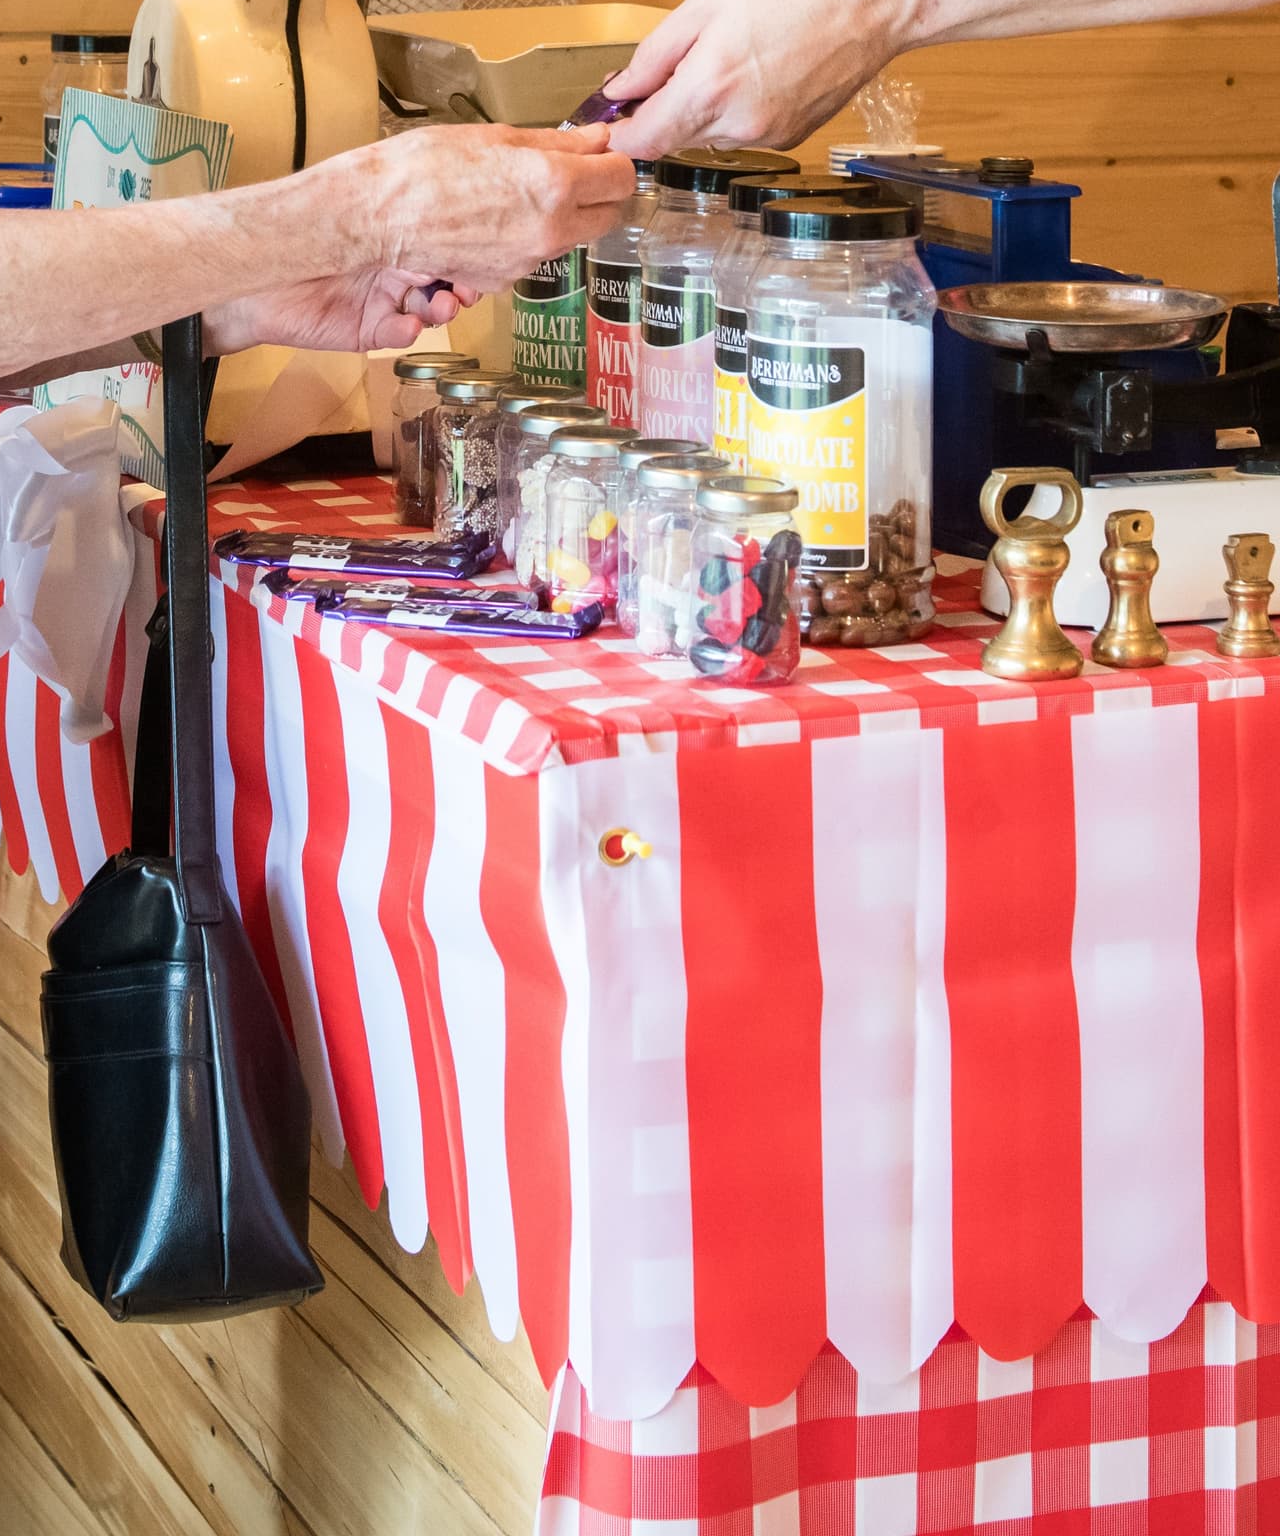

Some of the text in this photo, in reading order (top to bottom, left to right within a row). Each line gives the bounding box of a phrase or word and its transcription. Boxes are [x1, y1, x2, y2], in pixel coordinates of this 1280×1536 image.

[596, 330, 640, 377] WIN
[751, 355, 841, 383] BERRYMANS
[596, 377, 640, 422] GUM
